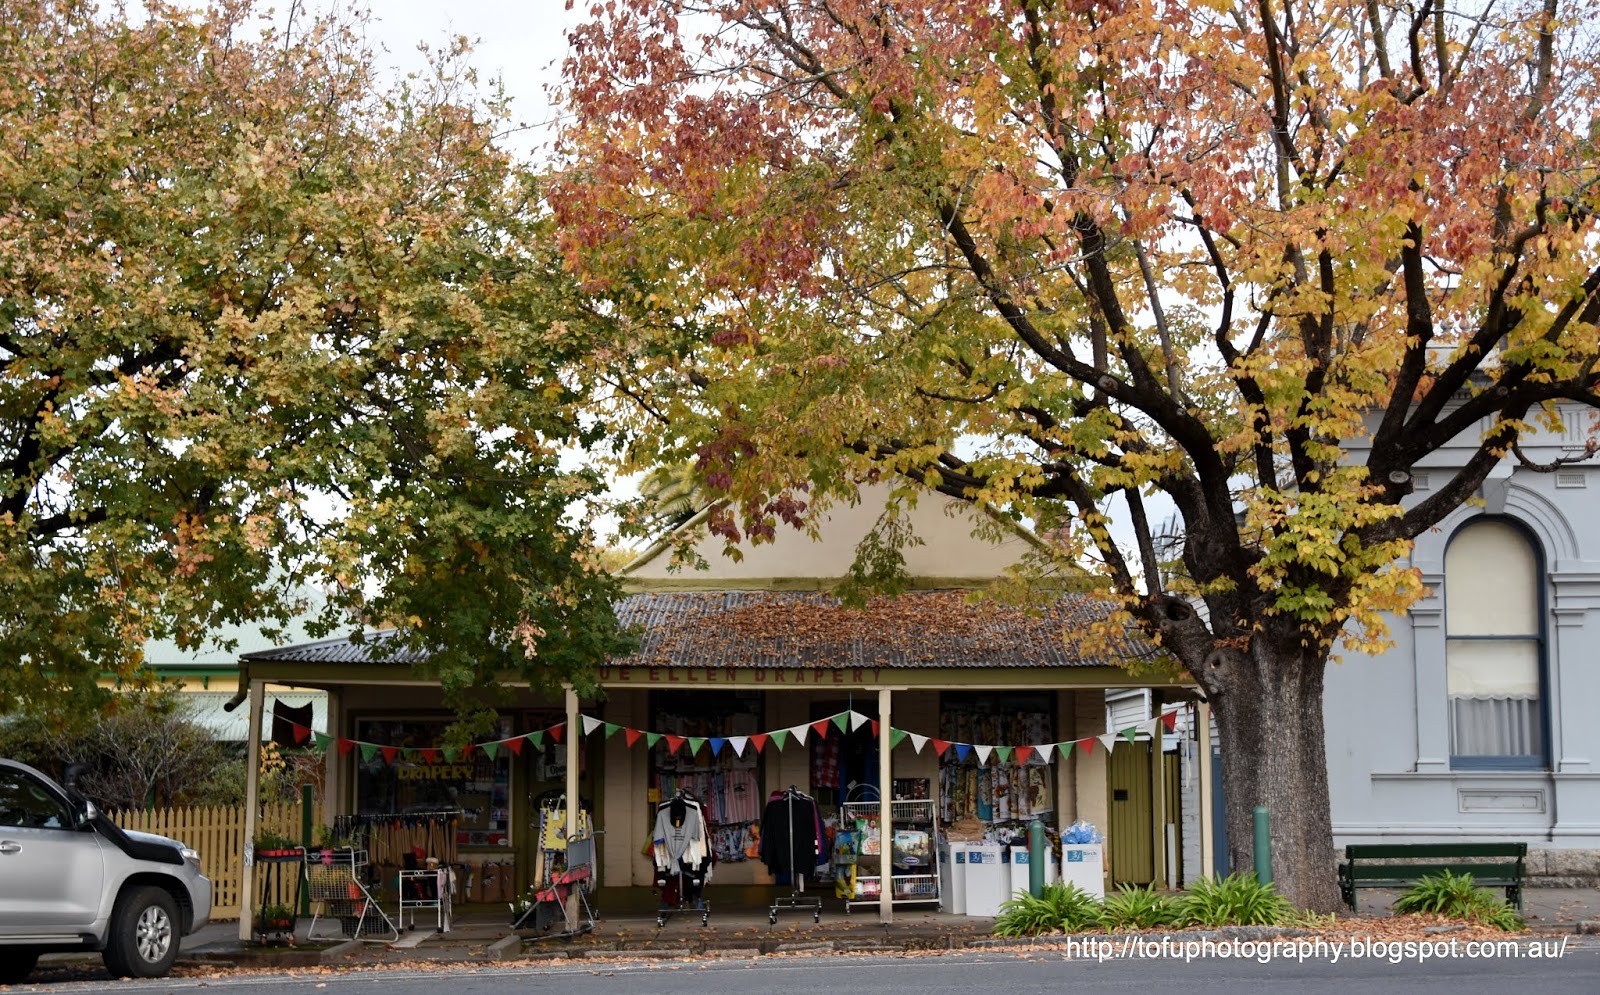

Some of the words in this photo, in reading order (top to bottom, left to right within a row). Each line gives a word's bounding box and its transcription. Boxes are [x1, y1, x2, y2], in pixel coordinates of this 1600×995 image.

[599, 666, 630, 681] UE
[649, 666, 736, 682] ELLEN
[754, 667, 880, 683] DRAPERY
